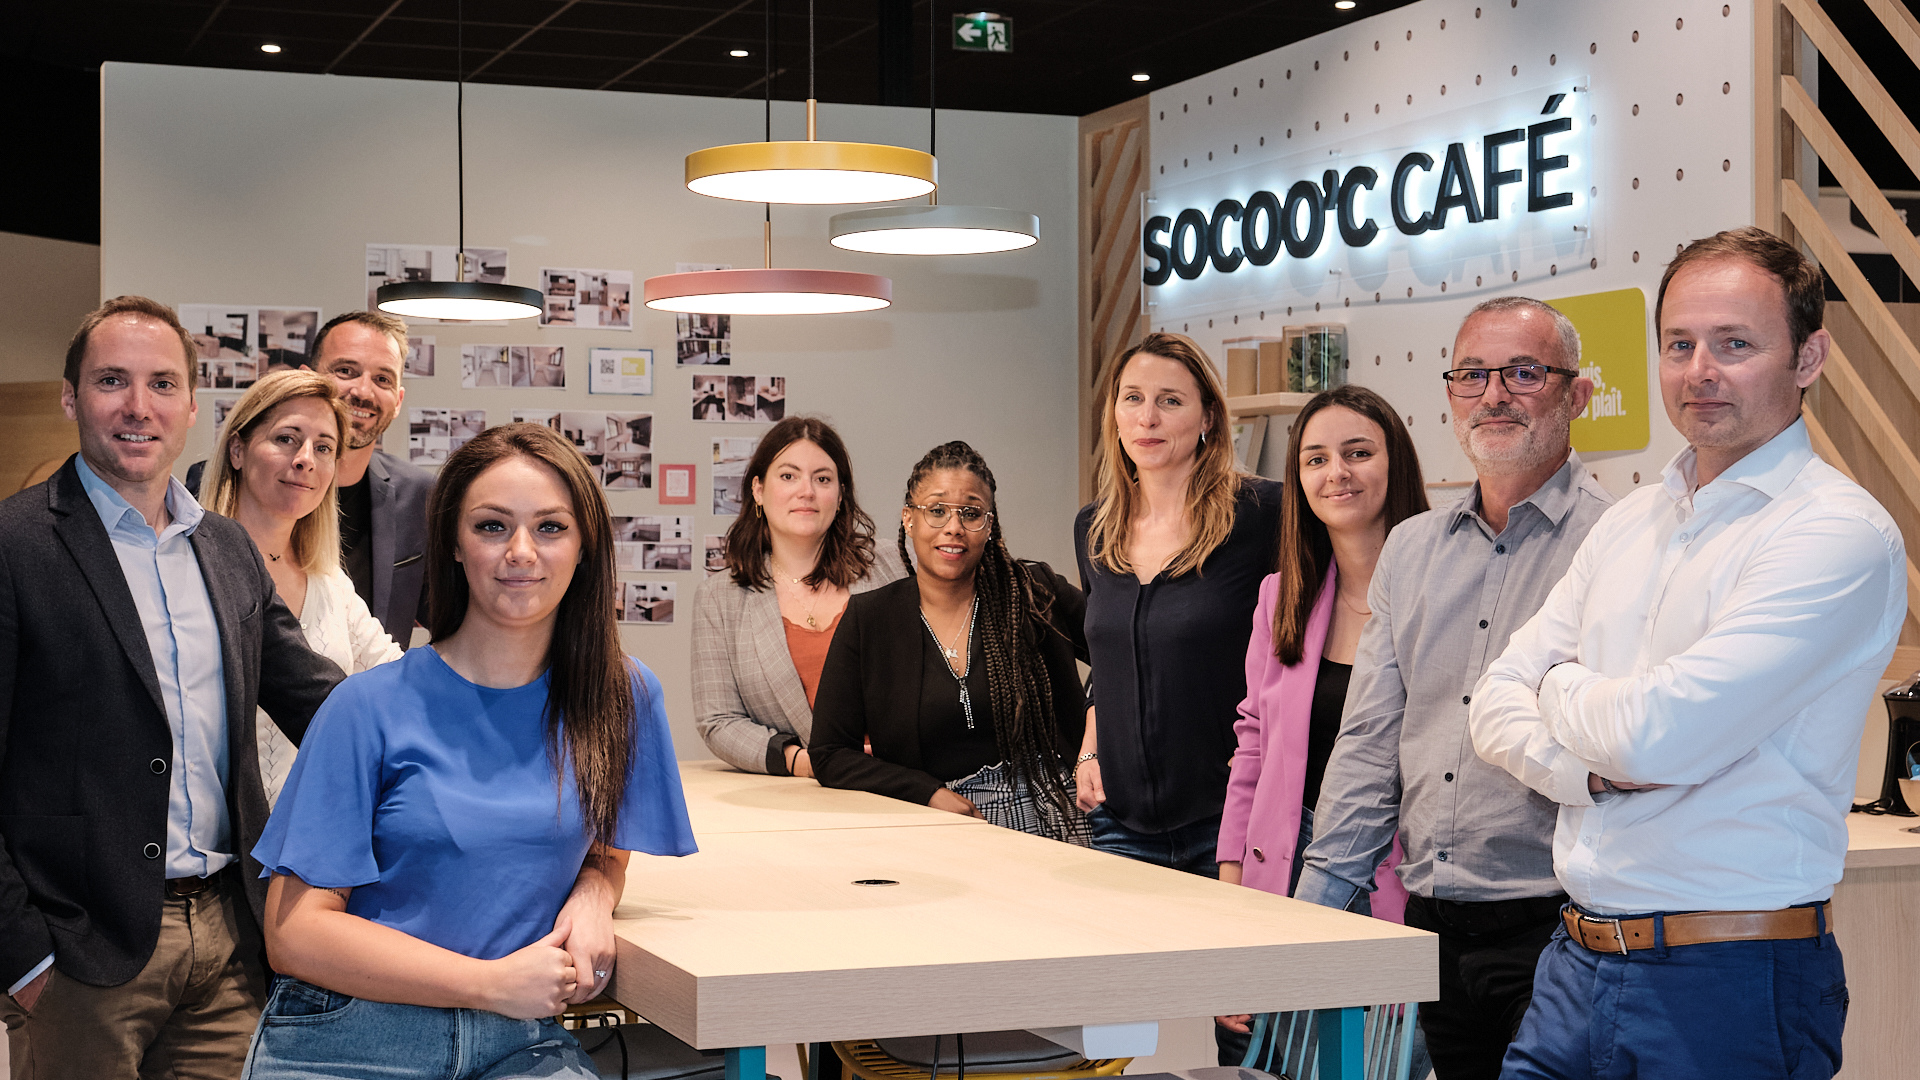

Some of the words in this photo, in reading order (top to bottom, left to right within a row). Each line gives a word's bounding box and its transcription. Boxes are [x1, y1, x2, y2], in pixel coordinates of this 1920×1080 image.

[1143, 166, 1379, 286] SOCOO'C
[1391, 93, 1573, 236] CAFÉ
[1579, 361, 1606, 391] vis,
[1592, 387, 1627, 421] plaît.
